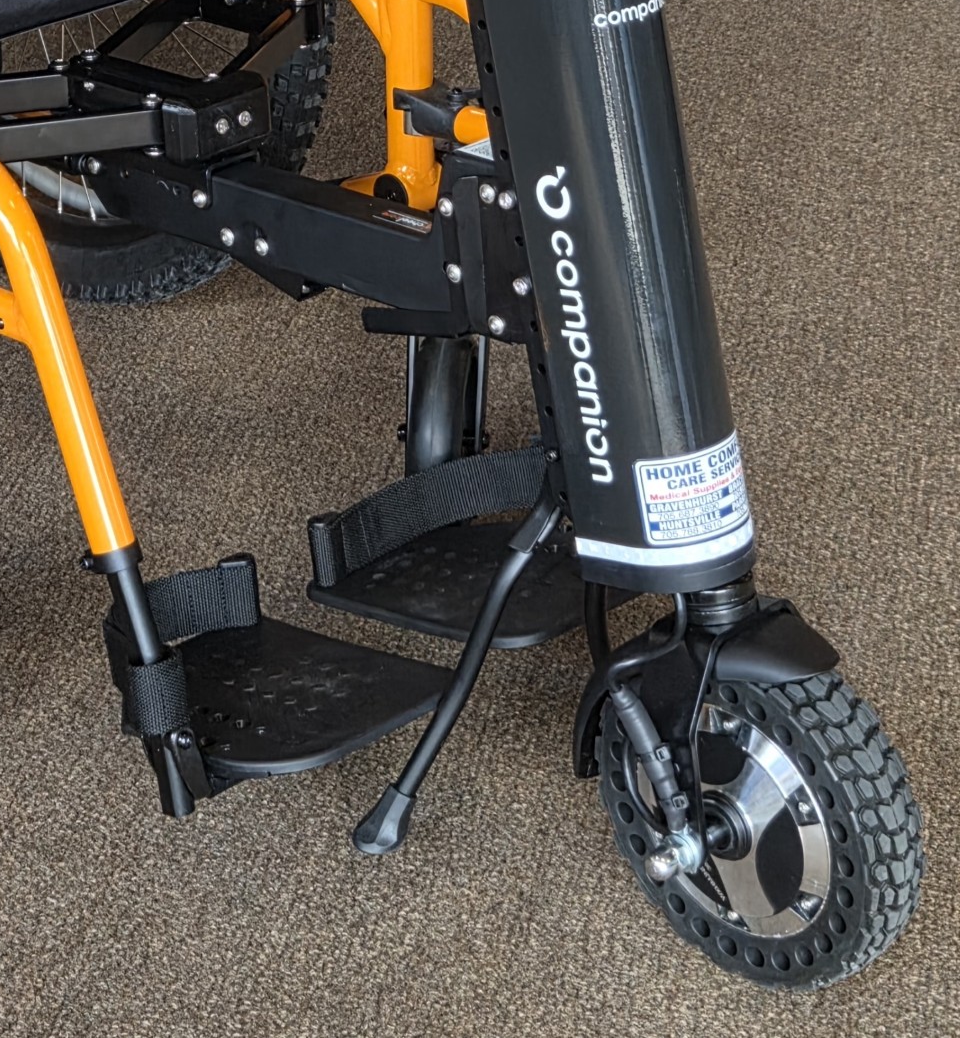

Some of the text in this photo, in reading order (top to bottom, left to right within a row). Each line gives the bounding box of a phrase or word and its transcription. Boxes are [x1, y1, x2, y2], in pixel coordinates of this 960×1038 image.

[551, 230, 613, 484] companion
[645, 460, 702, 481] HOME
[667, 473, 707, 490] CARE
[650, 490, 690, 501] Medical
[693, 476, 729, 495] Supplies
[649, 490, 723, 513] GRAVENHURST
[659, 510, 721, 531] HUNTSVILLE
